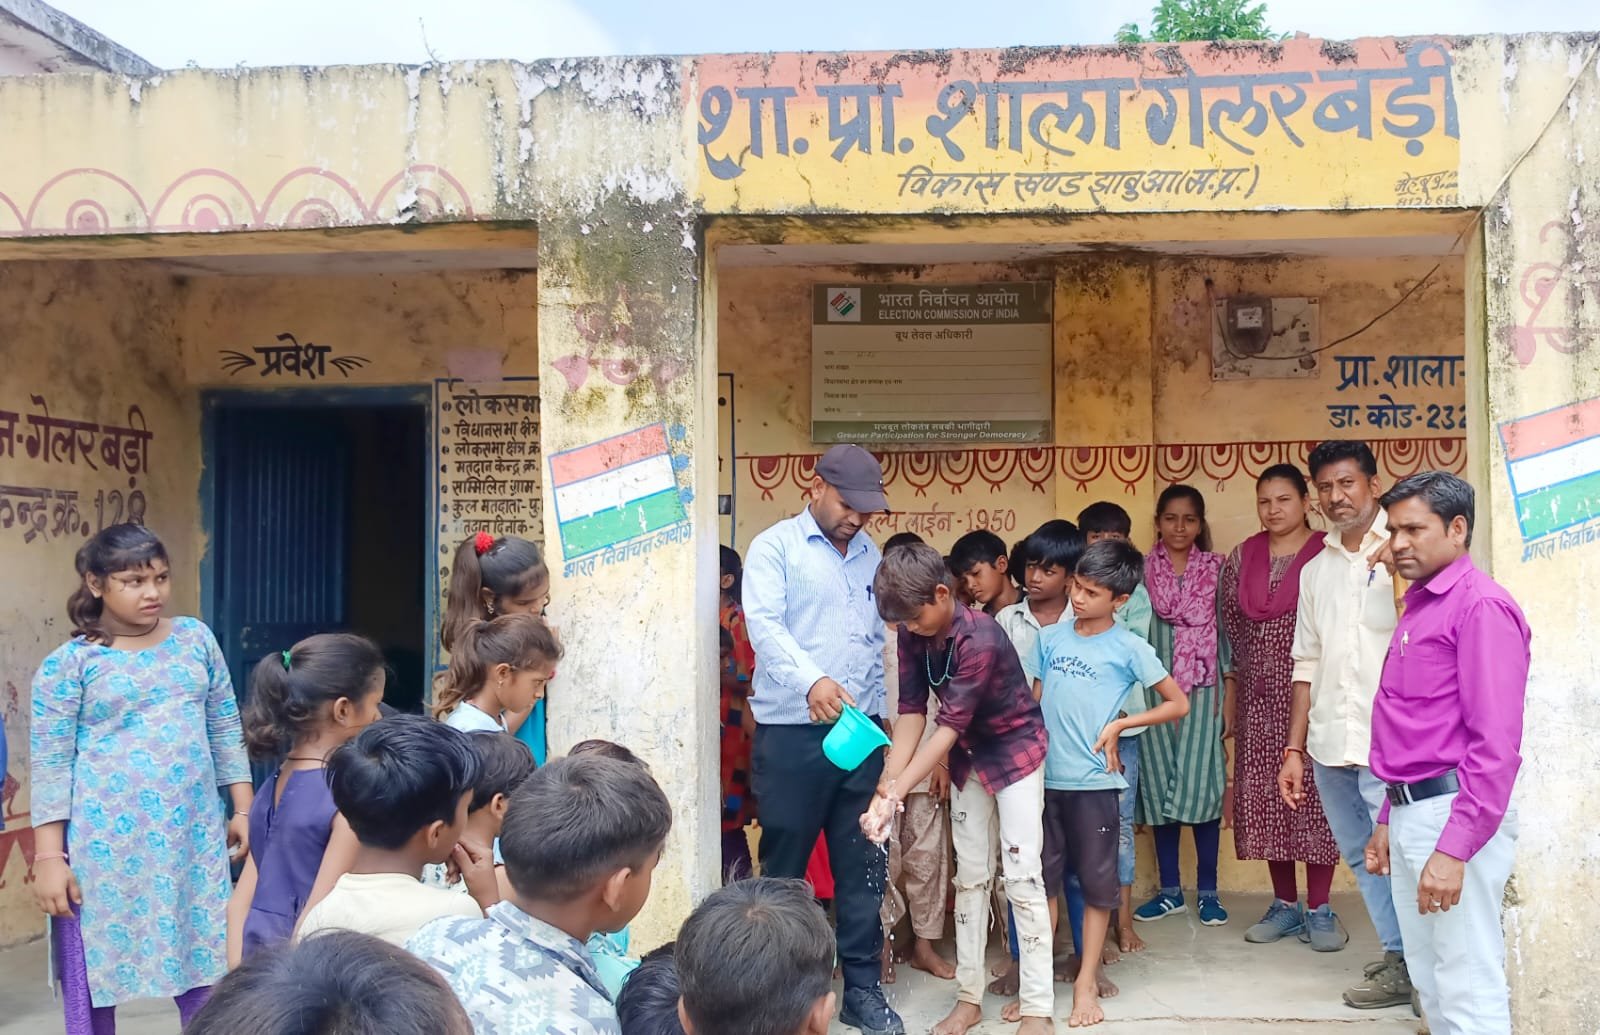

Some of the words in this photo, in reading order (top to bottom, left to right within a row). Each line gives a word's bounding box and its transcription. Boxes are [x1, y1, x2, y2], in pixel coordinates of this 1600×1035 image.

[815, 84, 914, 162] प्रा.
[897, 165, 1011, 205] विकास
[1014, 172, 1092, 202] खण्ड
[878, 292, 914, 307] भारत
[918, 288, 971, 307] निर्वाचन
[976, 288, 1020, 306] आयोग
[878, 309, 922, 320] ELECTION
[923, 309, 981, 320] COMMISSION
[982, 308, 994, 319] OF
[995, 308, 1020, 319] INDIA
[895, 330, 909, 342] बूथ
[911, 328, 933, 340] लेवल
[935, 328, 974, 340] अधिकारी
[252, 333, 332, 380] प्रवेश
[1334, 355, 1379, 391] प्रा.
[454, 419, 519, 439] विधानसभा
[836, 431, 869, 440] Greater
[870, 431, 925, 441] Participation
[926, 431, 939, 439] for
[940, 431, 978, 440] Stronger
[980, 431, 1028, 440] Democracy
[454, 460, 493, 478] मतदान
[452, 499, 480, 519] कुल
[563, 553, 599, 579] भारत
[654, 522, 693, 549] आयोग
[1521, 538, 1556, 562] भारत
